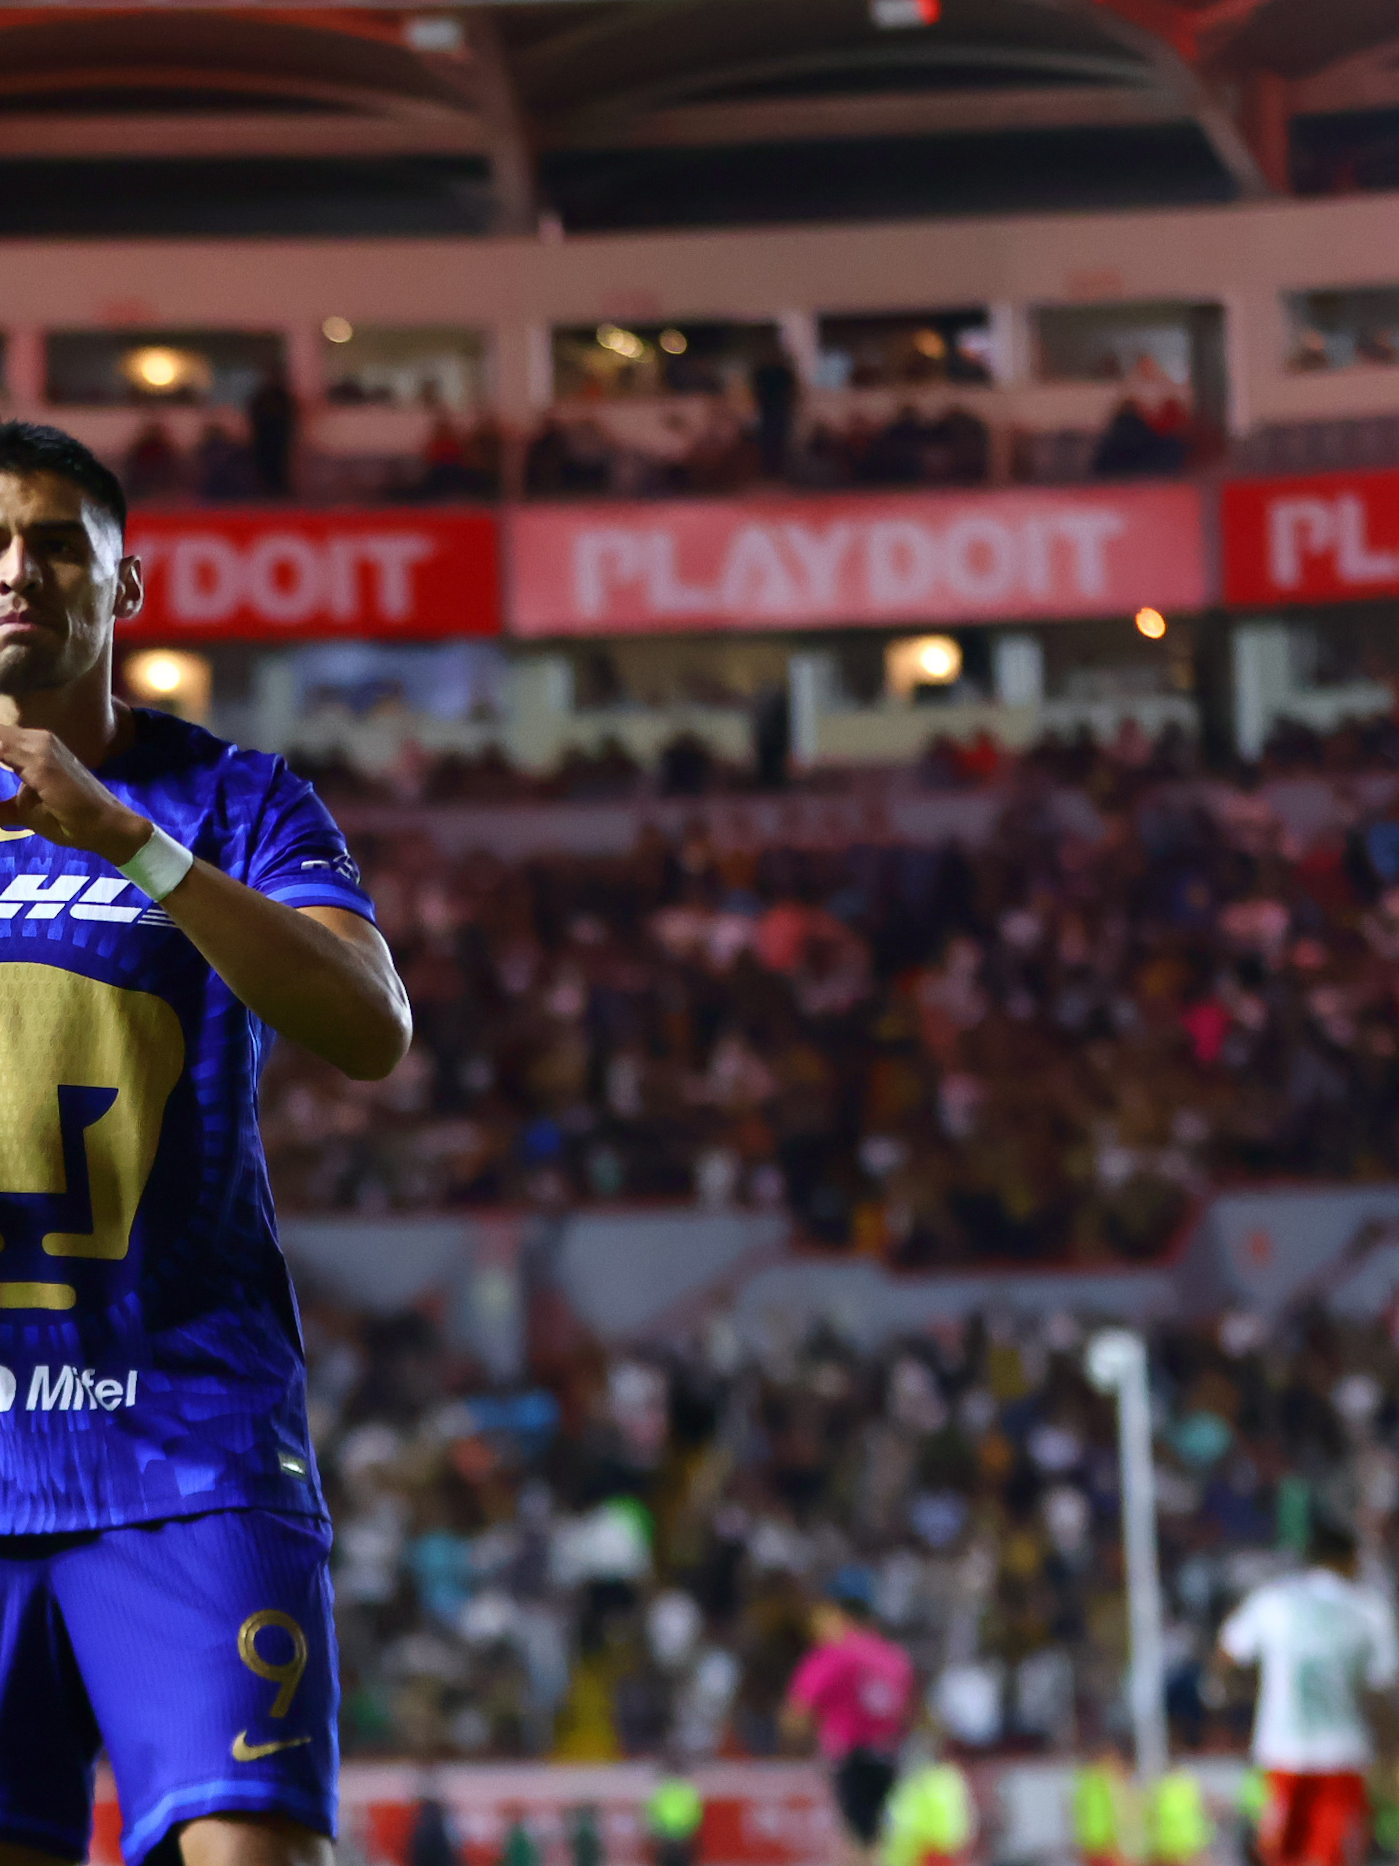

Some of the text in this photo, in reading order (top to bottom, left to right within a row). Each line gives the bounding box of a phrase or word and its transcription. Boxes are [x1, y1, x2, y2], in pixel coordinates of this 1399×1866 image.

[572, 510, 1122, 619] PLAYDOIT
[25, 1364, 138, 1412] Mifel
[237, 1608, 308, 1719] 9
